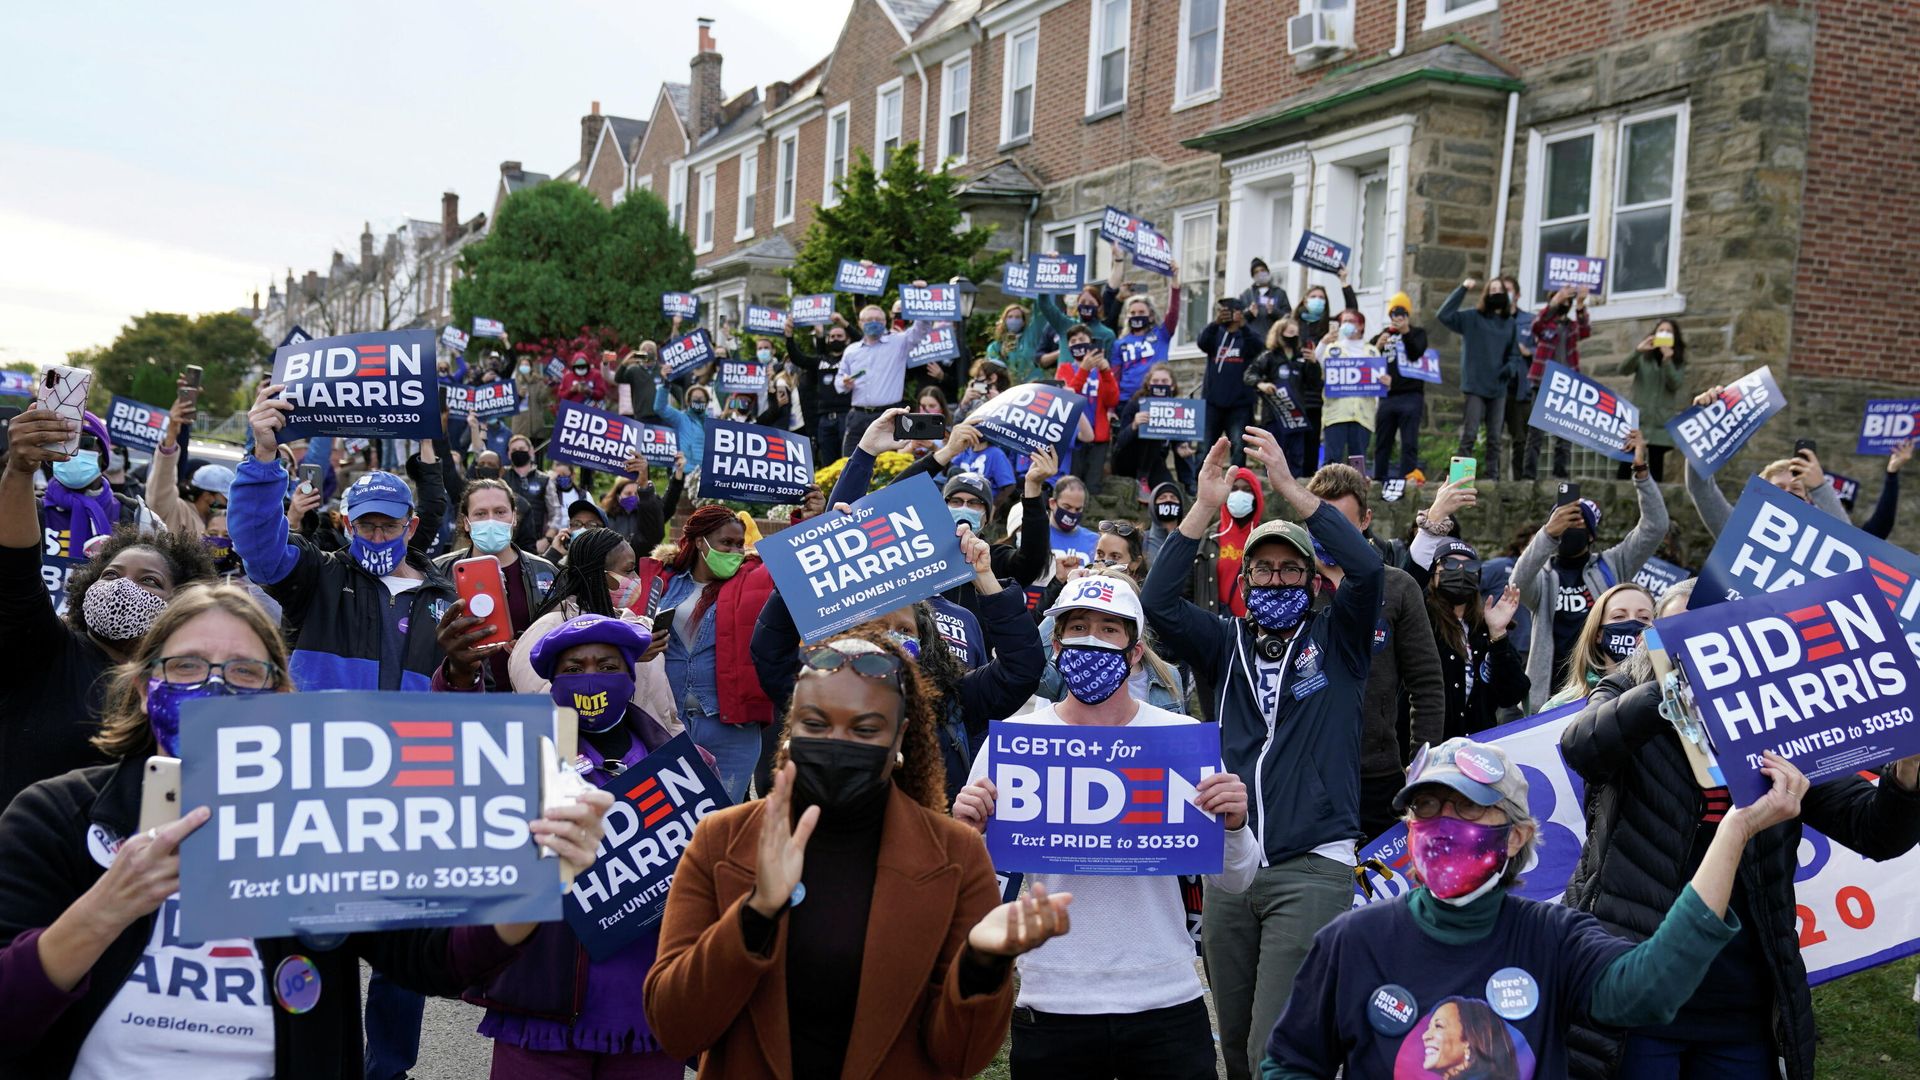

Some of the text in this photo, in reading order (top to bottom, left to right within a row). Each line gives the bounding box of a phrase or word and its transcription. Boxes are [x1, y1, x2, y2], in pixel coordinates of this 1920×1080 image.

[1105, 210, 1150, 232] BIDE
[1104, 223, 1135, 242] HARR
[1137, 229, 1171, 250] BIDEN
[1137, 244, 1171, 263] HARRIS
[1303, 249, 1340, 269] HARRIS
[1306, 239, 1344, 260] BIDEN
[842, 263, 886, 278] BIDEN
[1008, 266, 1029, 281] BID
[1037, 263, 1078, 275] BIDEN
[1549, 257, 1602, 273] BIDEN
[840, 274, 883, 287] HARRIS
[1036, 273, 1077, 284] HARRIS
[1548, 269, 1600, 284] HARRIS
[663, 294, 697, 307] BIDEN
[793, 297, 831, 309] BIDEN
[903, 288, 955, 301] BIDEN
[663, 303, 696, 314] HARRIS
[749, 307, 786, 320] BIDEN
[792, 306, 830, 317] HARRIS
[905, 300, 956, 311] HARRIS
[662, 332, 704, 361] BIDEN
[665, 343, 708, 370] HARRIS
[283, 343, 422, 383] BIDEN
[723, 363, 767, 377] BIDEN
[722, 373, 766, 385] HARRIS
[1325, 367, 1385, 385] BIDEN
[278, 379, 425, 408] HARRIS
[446, 386, 476, 403] BIDE
[475, 382, 513, 401] BIDEN
[1550, 370, 1632, 425] BIDEN
[475, 395, 514, 412] HARRIS
[1012, 389, 1074, 424] DEN
[1150, 407, 1196, 419] BIDEN
[1276, 387, 1307, 427] BIDEN
[1677, 373, 1763, 444] BIDEN
[289, 413, 421, 424] Text UNITED to 30330
[990, 404, 1064, 443] ARRIS
[1149, 418, 1195, 429] HARRIS
[1544, 391, 1633, 439] HARRIS
[1691, 385, 1769, 458] HARRIS
[1863, 412, 1920, 438] BIDE
[563, 408, 638, 446] BIDEN
[643, 428, 677, 445] DEN
[986, 421, 1018, 439] UNITED
[1559, 416, 1590, 437] UNITED
[1590, 431, 1598, 439] to
[1598, 434, 1625, 450] 30330
[559, 427, 637, 461] HARRIS
[641, 441, 678, 456] ARRIS
[714, 428, 806, 465] BIDEN
[1718, 427, 1743, 454] UNITED
[560, 446, 573, 455] Text
[573, 448, 601, 463] UNITED
[712, 454, 809, 485] HARRIS
[369, 485, 397, 493] AMERICA
[714, 480, 731, 488] Text
[731, 481, 766, 492] UNITED
[776, 486, 804, 496] 30330
[1158, 503, 1180, 517] VOTE
[788, 506, 875, 548] WOMEN for
[795, 505, 924, 575] BIDEN
[363, 545, 393, 563] VOTE
[361, 559, 393, 576] BLUE
[808, 533, 936, 599] HARRIS
[817, 602, 842, 618] Text
[840, 579, 895, 609] WOMEN
[896, 576, 908, 588] to
[907, 559, 948, 583] 30330
[1072, 586, 1114, 603] JOE
[1078, 580, 1115, 591] TEAM
[1555, 591, 1596, 613] BIDE
[935, 611, 965, 628] 2020
[1684, 593, 1886, 691] BIDEN
[1294, 643, 1316, 667] BIDEN
[1296, 649, 1319, 671] HARRIS
[1083, 670, 1109, 694] vote
[573, 690, 609, 711] VOTE
[1712, 651, 1907, 742] HARRIS
[996, 734, 1142, 762] LGBTQ+ for
[1746, 749, 1779, 771] Tet
[1779, 727, 1846, 760] UNITED
[1848, 724, 1862, 740] to
[1862, 706, 1914, 735] 30330
[217, 721, 525, 795] BIDEN
[995, 763, 1217, 825] BIDEN
[597, 755, 706, 858] DEN
[218, 795, 530, 861] HARRIS
[1011, 832, 1199, 849] Text PRIDE to 30330
[229, 865, 518, 899] Text UNITED to 30330
[598, 908, 625, 930] Text
[1795, 885, 1876, 950] 20
[284, 969, 314, 998] JOE
[1492, 976, 1529, 989] here's
[1502, 987, 1522, 998] the
[1374, 998, 1409, 1024] HARRIS
[1377, 990, 1414, 1017] BIDEN
[1500, 997, 1528, 1009] deal
[121, 1011, 254, 1037] JoeBiden.com
